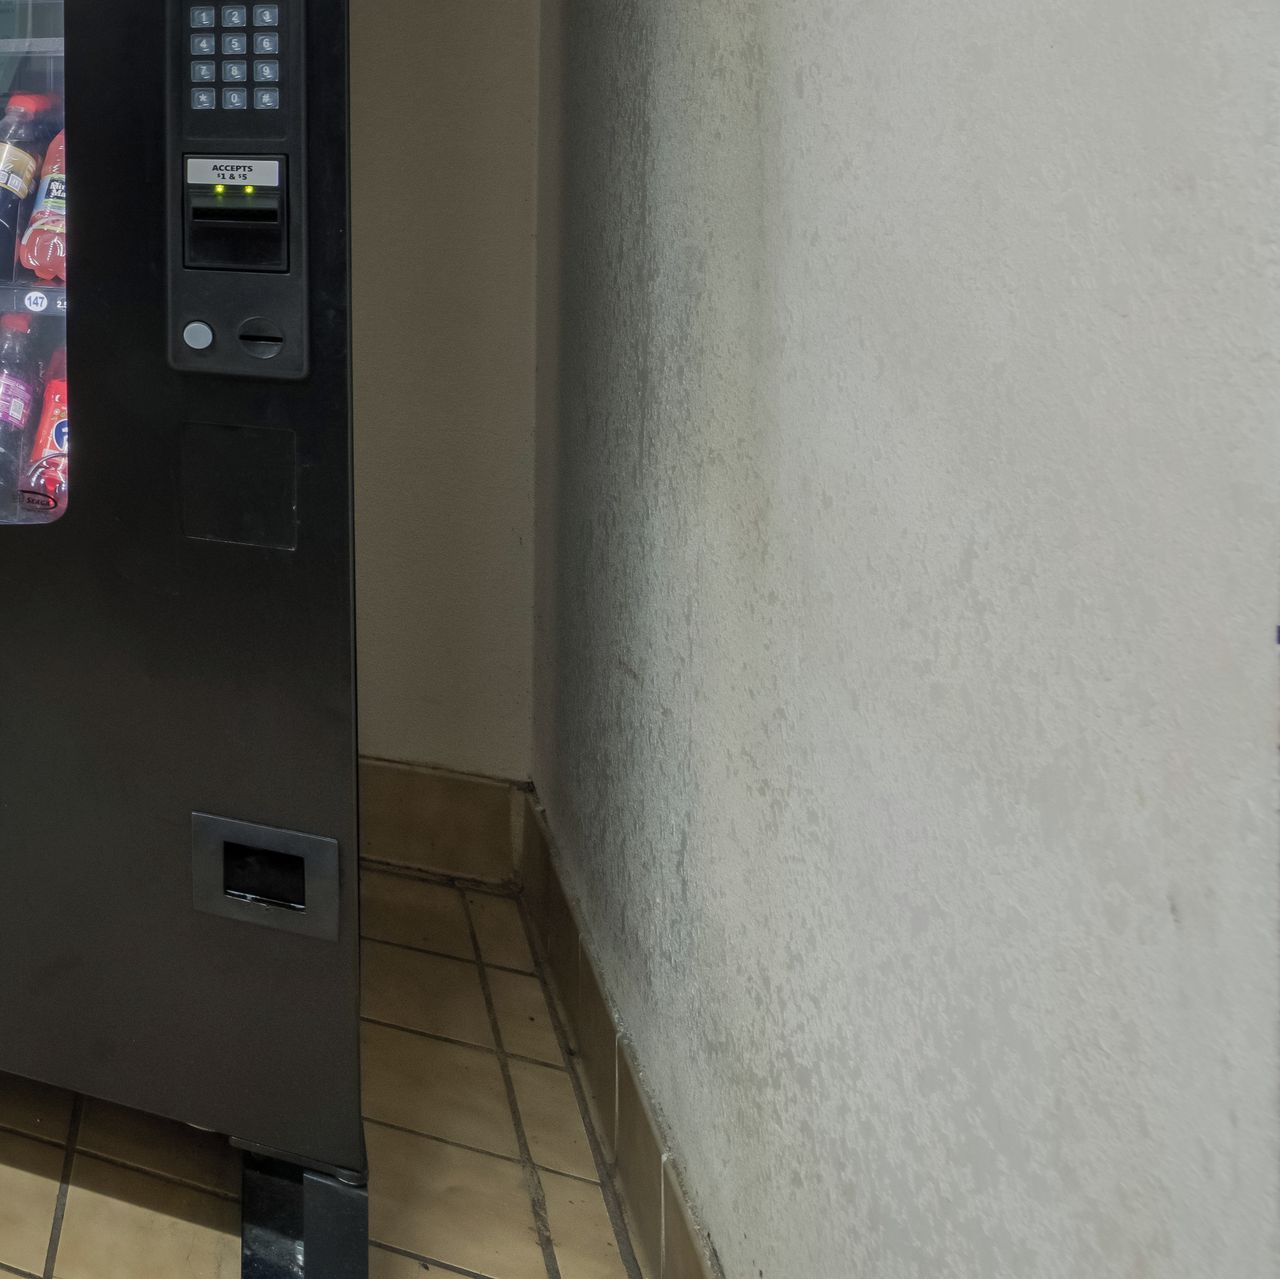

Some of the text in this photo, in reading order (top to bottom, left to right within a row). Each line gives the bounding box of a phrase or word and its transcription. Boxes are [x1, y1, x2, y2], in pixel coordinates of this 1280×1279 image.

[212, 164, 254, 173] ACCEPTS
[217, 172, 248, 181] $1 & $5
[26, 295, 46, 307] 147
